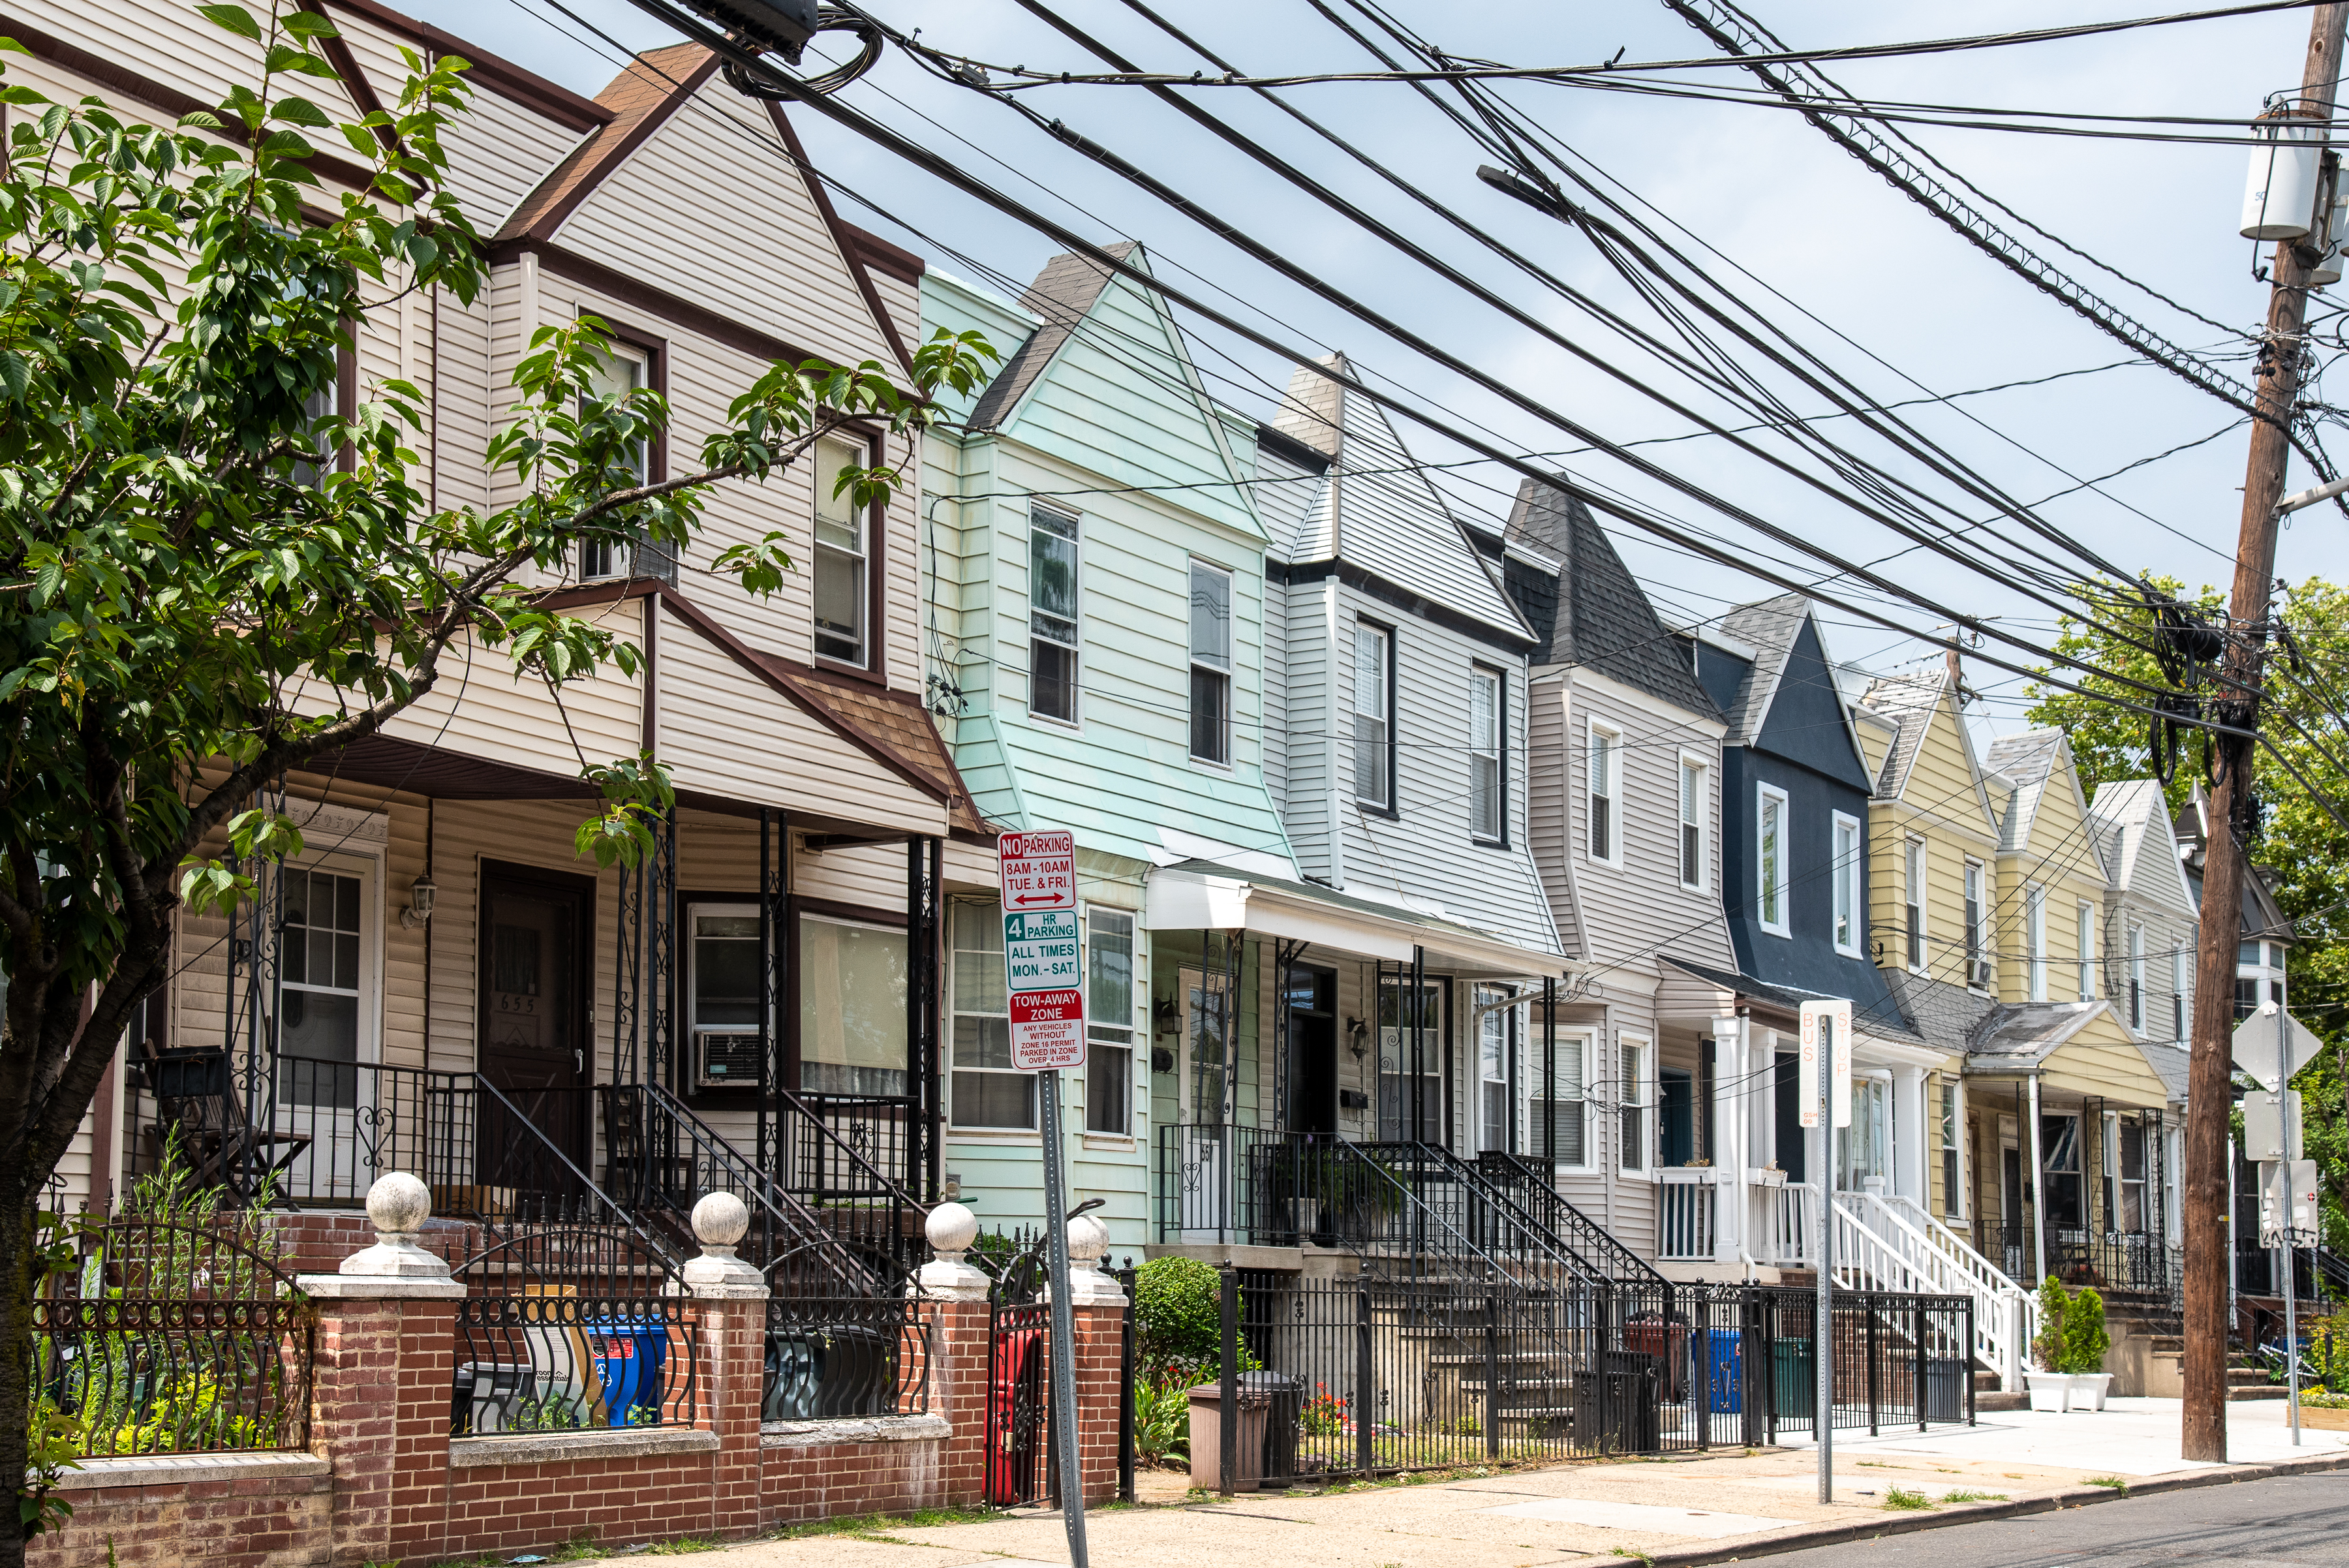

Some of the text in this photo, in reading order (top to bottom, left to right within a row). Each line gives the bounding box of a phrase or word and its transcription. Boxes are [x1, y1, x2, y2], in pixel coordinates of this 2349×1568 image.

[1002, 837, 1069, 855] NO PARKING
[1006, 863, 1031, 875] 8AM
[1039, 861, 1069, 873] 10AM
[1007, 876, 1070, 890] TUE. & FRI.
[1043, 914, 1056, 925] HR
[1008, 918, 1022, 938] 4
[1028, 925, 1073, 938] PARKING
[1011, 944, 1075, 959] ALL TIMES
[1013, 964, 1042, 977] MON.
[1052, 962, 1075, 975] SAT.
[501, 994, 534, 1013] 655
[1013, 992, 1077, 1007] TOW-AWAY
[1030, 1008, 1063, 1021] ZONE
[1039, 1022, 1072, 1031] VEHICLES
[1030, 1031, 1066, 1039] WITHOUT
[1804, 1013, 1813, 1061] BUS
[1837, 1013, 1847, 1077] STOP
[1020, 1049, 1048, 1057] PARKED
